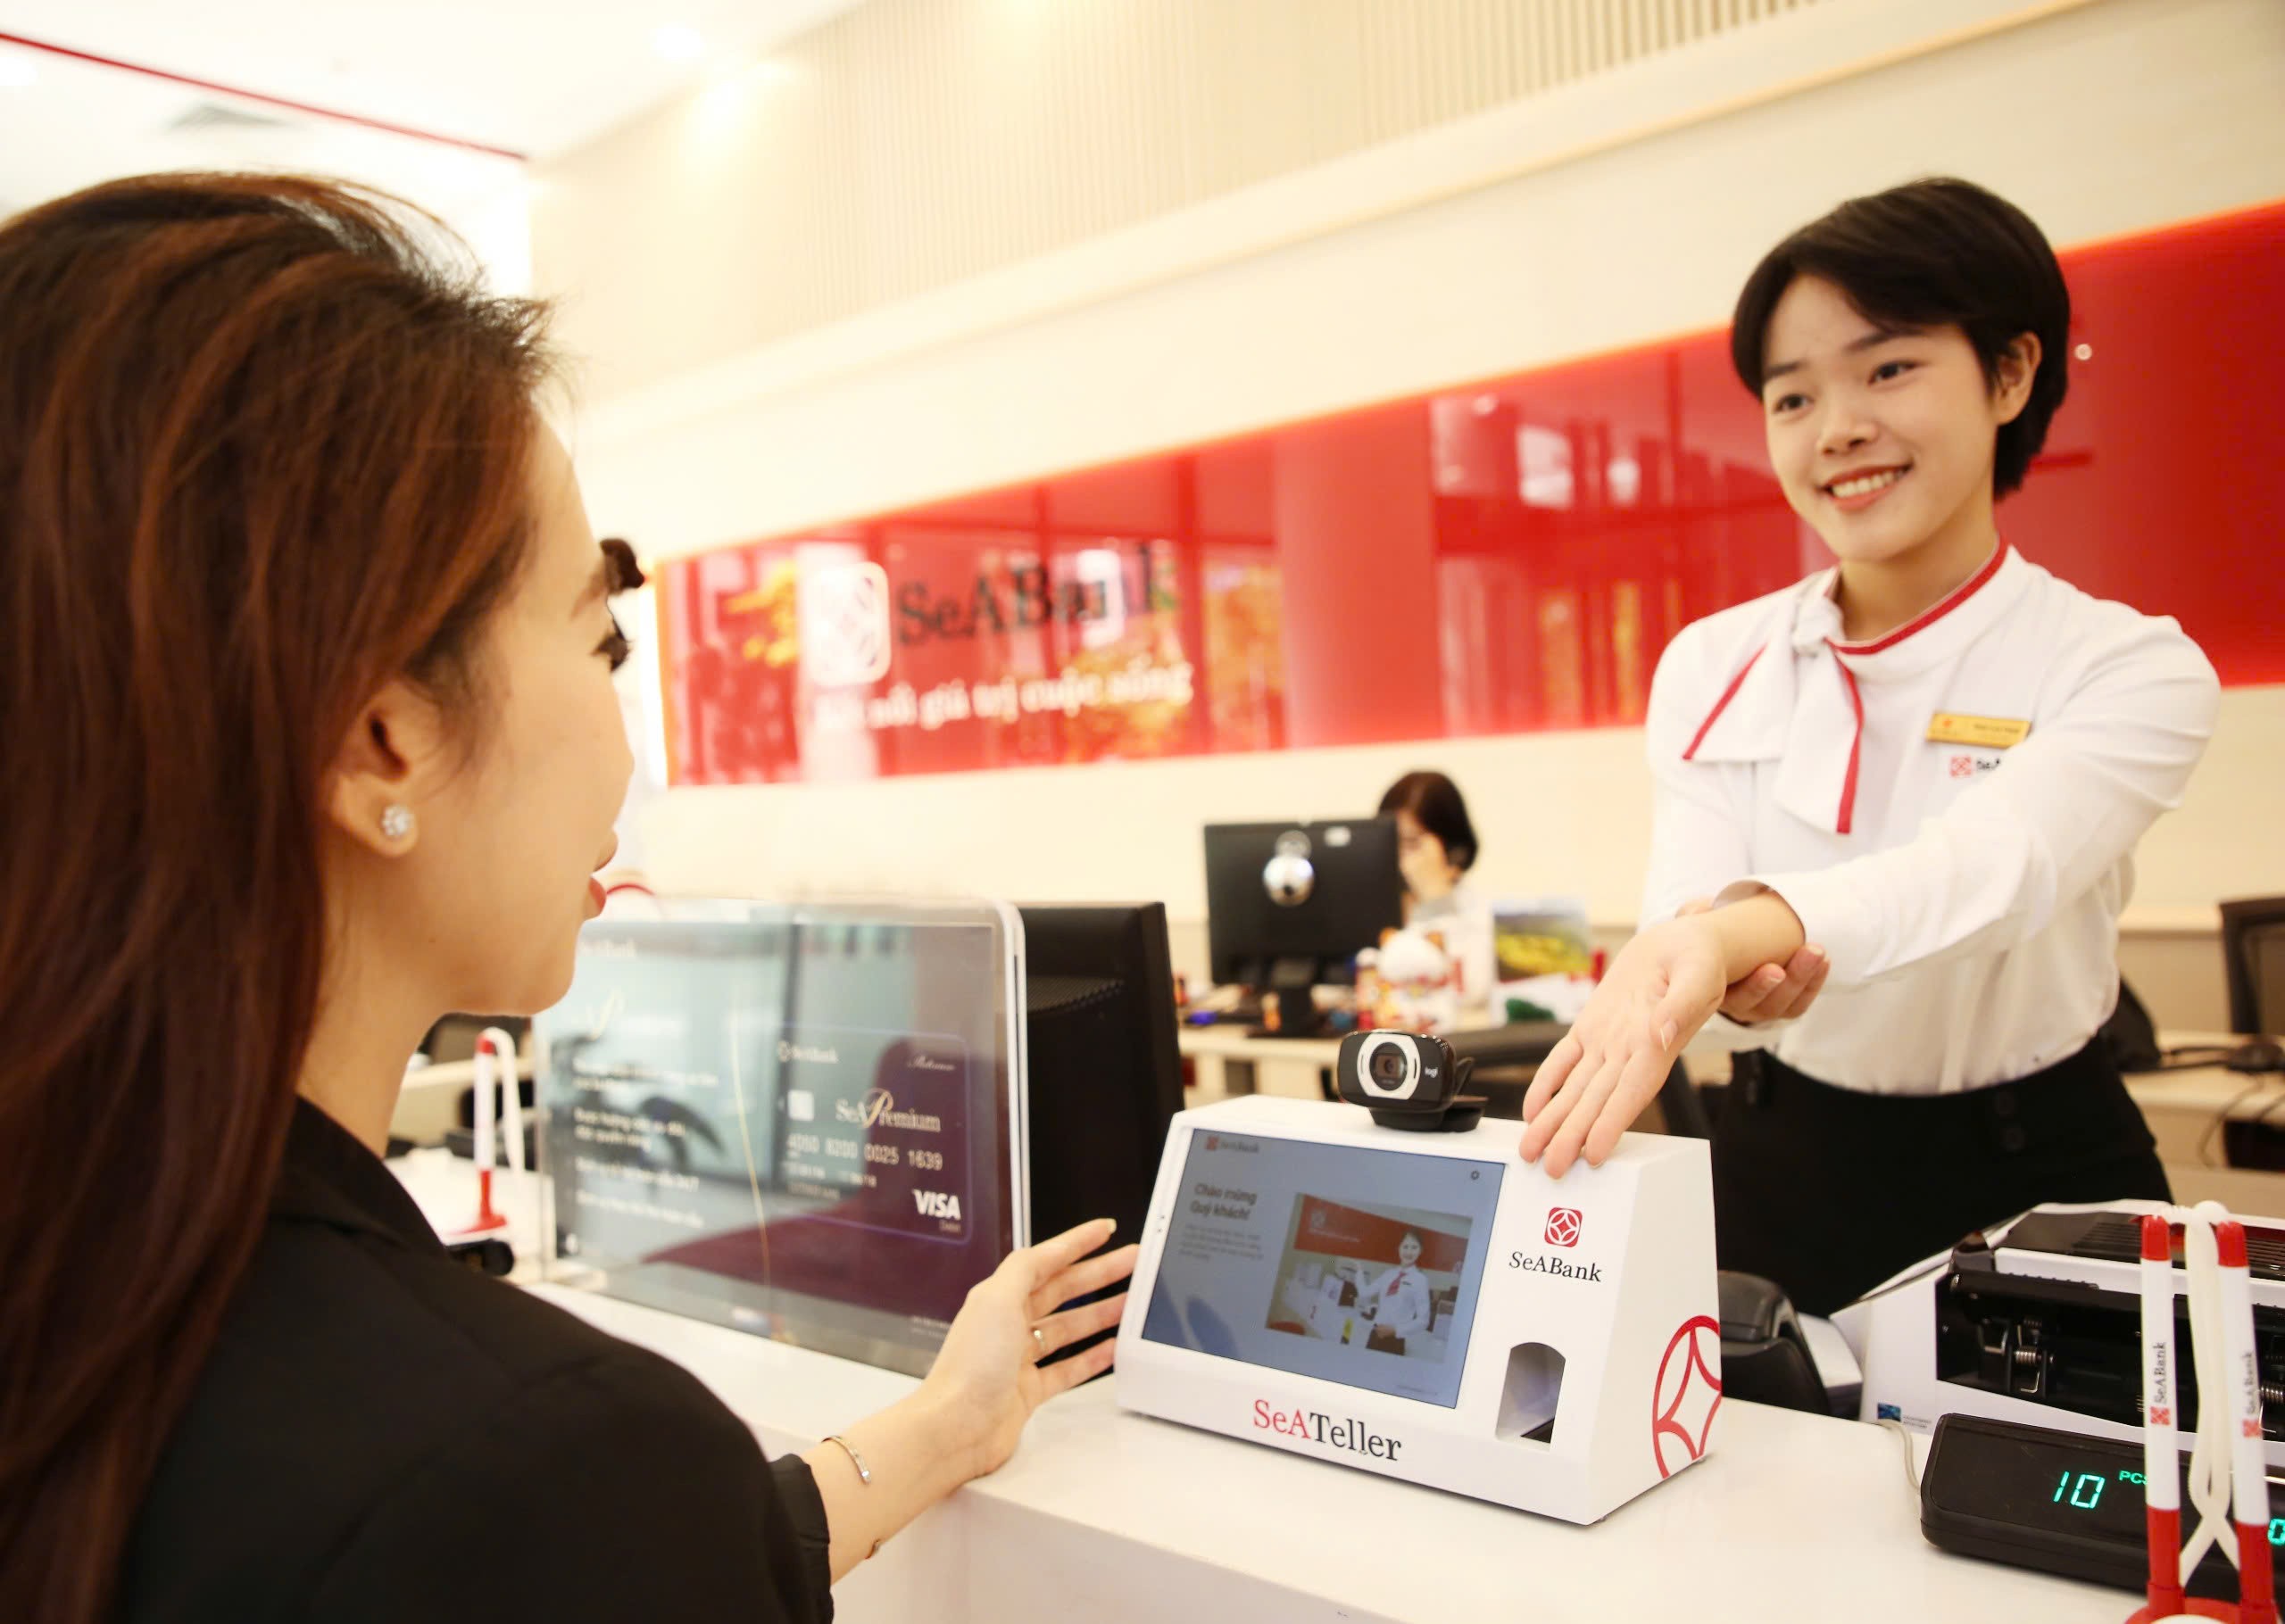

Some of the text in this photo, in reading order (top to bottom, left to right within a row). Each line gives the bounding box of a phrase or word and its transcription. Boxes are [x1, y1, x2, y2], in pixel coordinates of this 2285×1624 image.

[864, 1142, 899, 1165] 0025
[907, 1149, 943, 1171] 1639
[911, 1189, 961, 1221] VISA
[1508, 1250, 1603, 1282] SeABank
[2152, 1341, 2166, 1404] SeABank
[1252, 1398, 1402, 1462] SeATeller
[2053, 1471, 2106, 1509] 10
